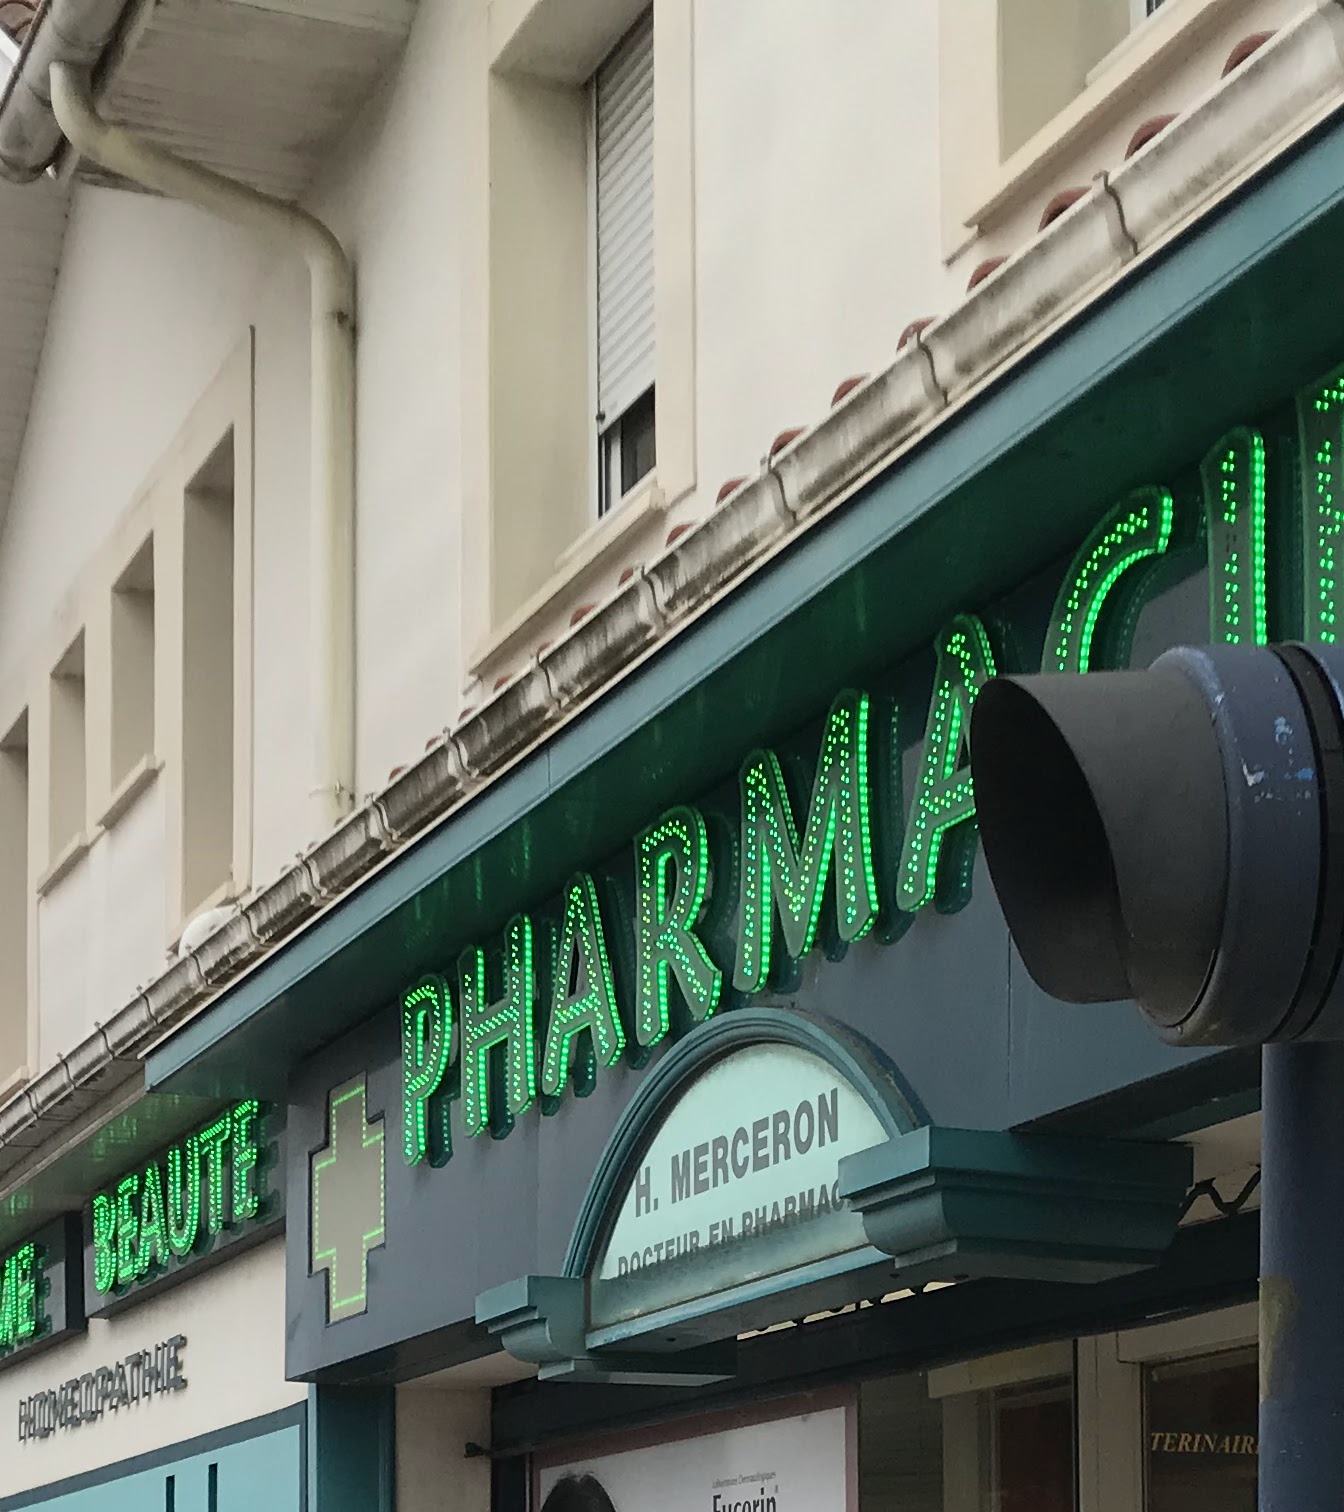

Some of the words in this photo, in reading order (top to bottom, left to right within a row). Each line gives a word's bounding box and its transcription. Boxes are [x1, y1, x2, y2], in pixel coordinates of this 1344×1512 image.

[635, 1167, 659, 1218] H.
[671, 1088, 838, 1204] MERCERON
[709, 1217, 735, 1244] EN
[1151, 1432, 1260, 1455] TERINAIR
